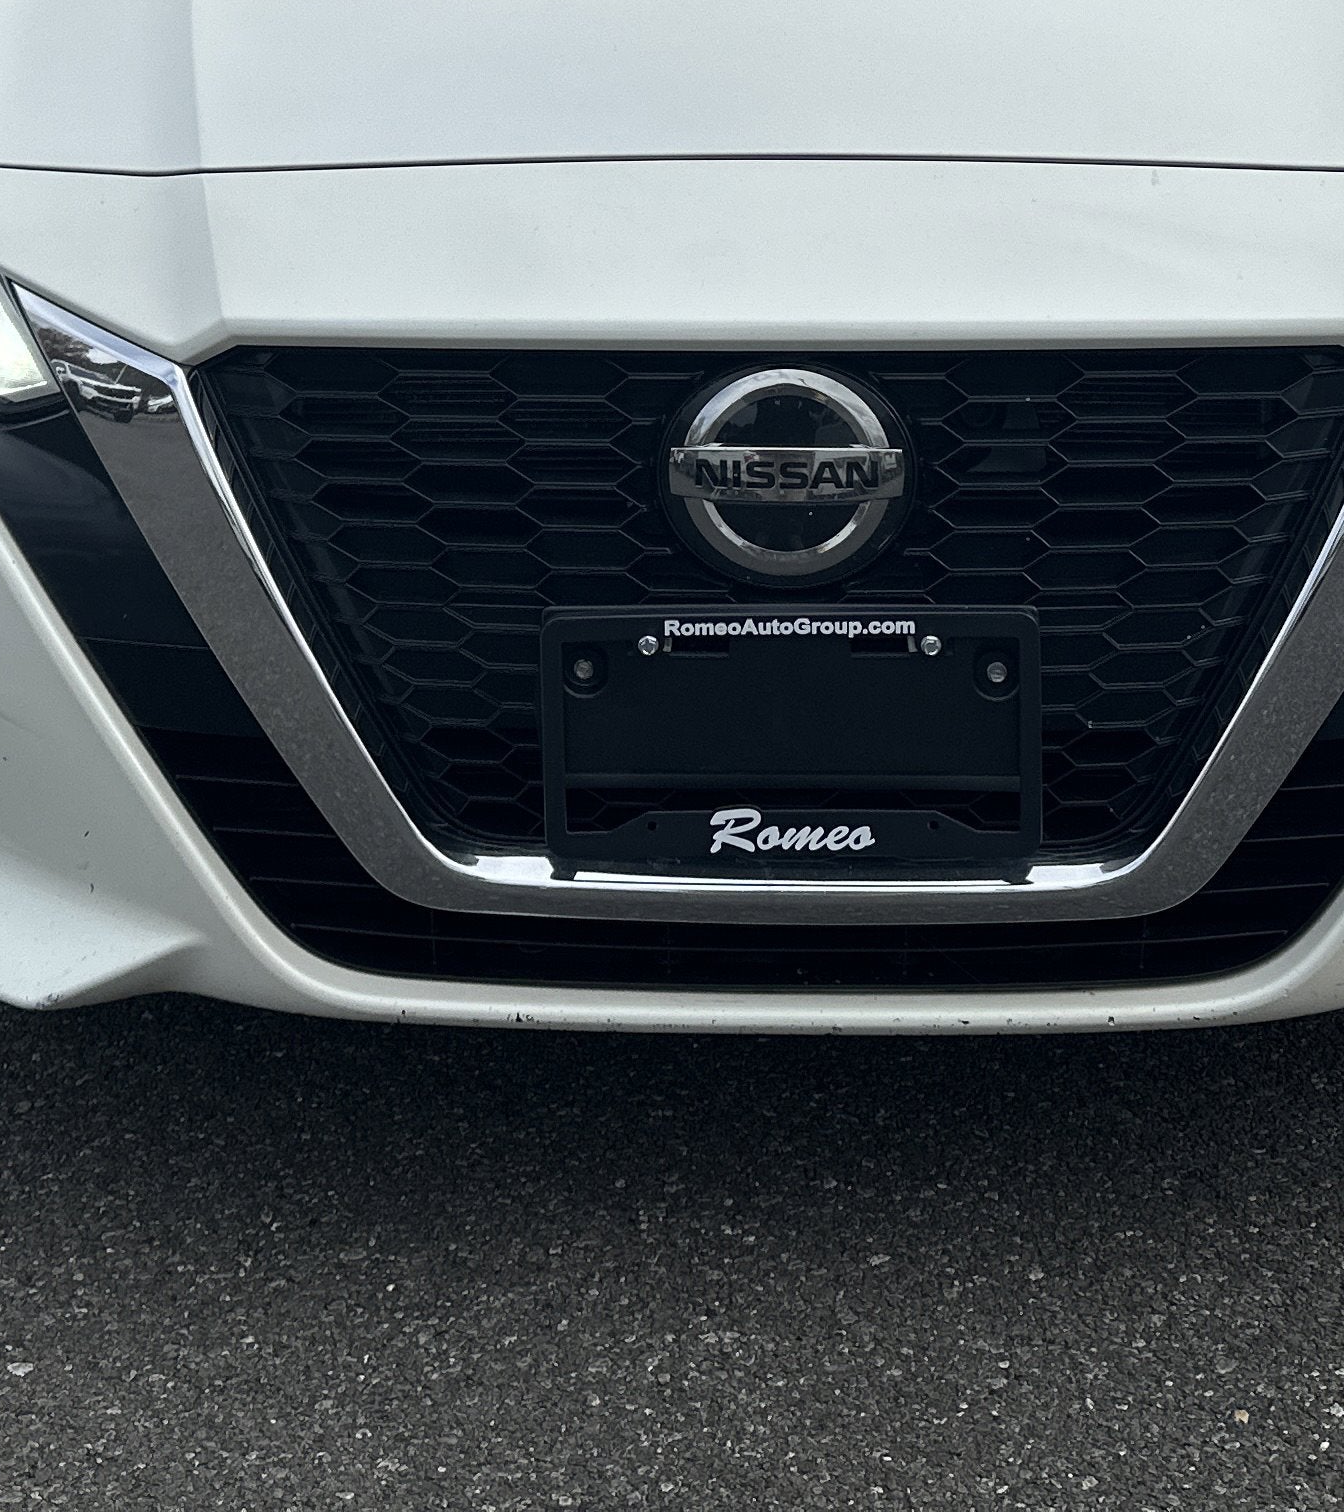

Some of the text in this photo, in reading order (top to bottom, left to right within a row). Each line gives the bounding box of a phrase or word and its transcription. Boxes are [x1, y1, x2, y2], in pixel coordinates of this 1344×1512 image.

[694, 458, 879, 489] NISSAN
[664, 617, 916, 638] RomeoAutoGroup.com
[709, 808, 876, 854] Romeo
